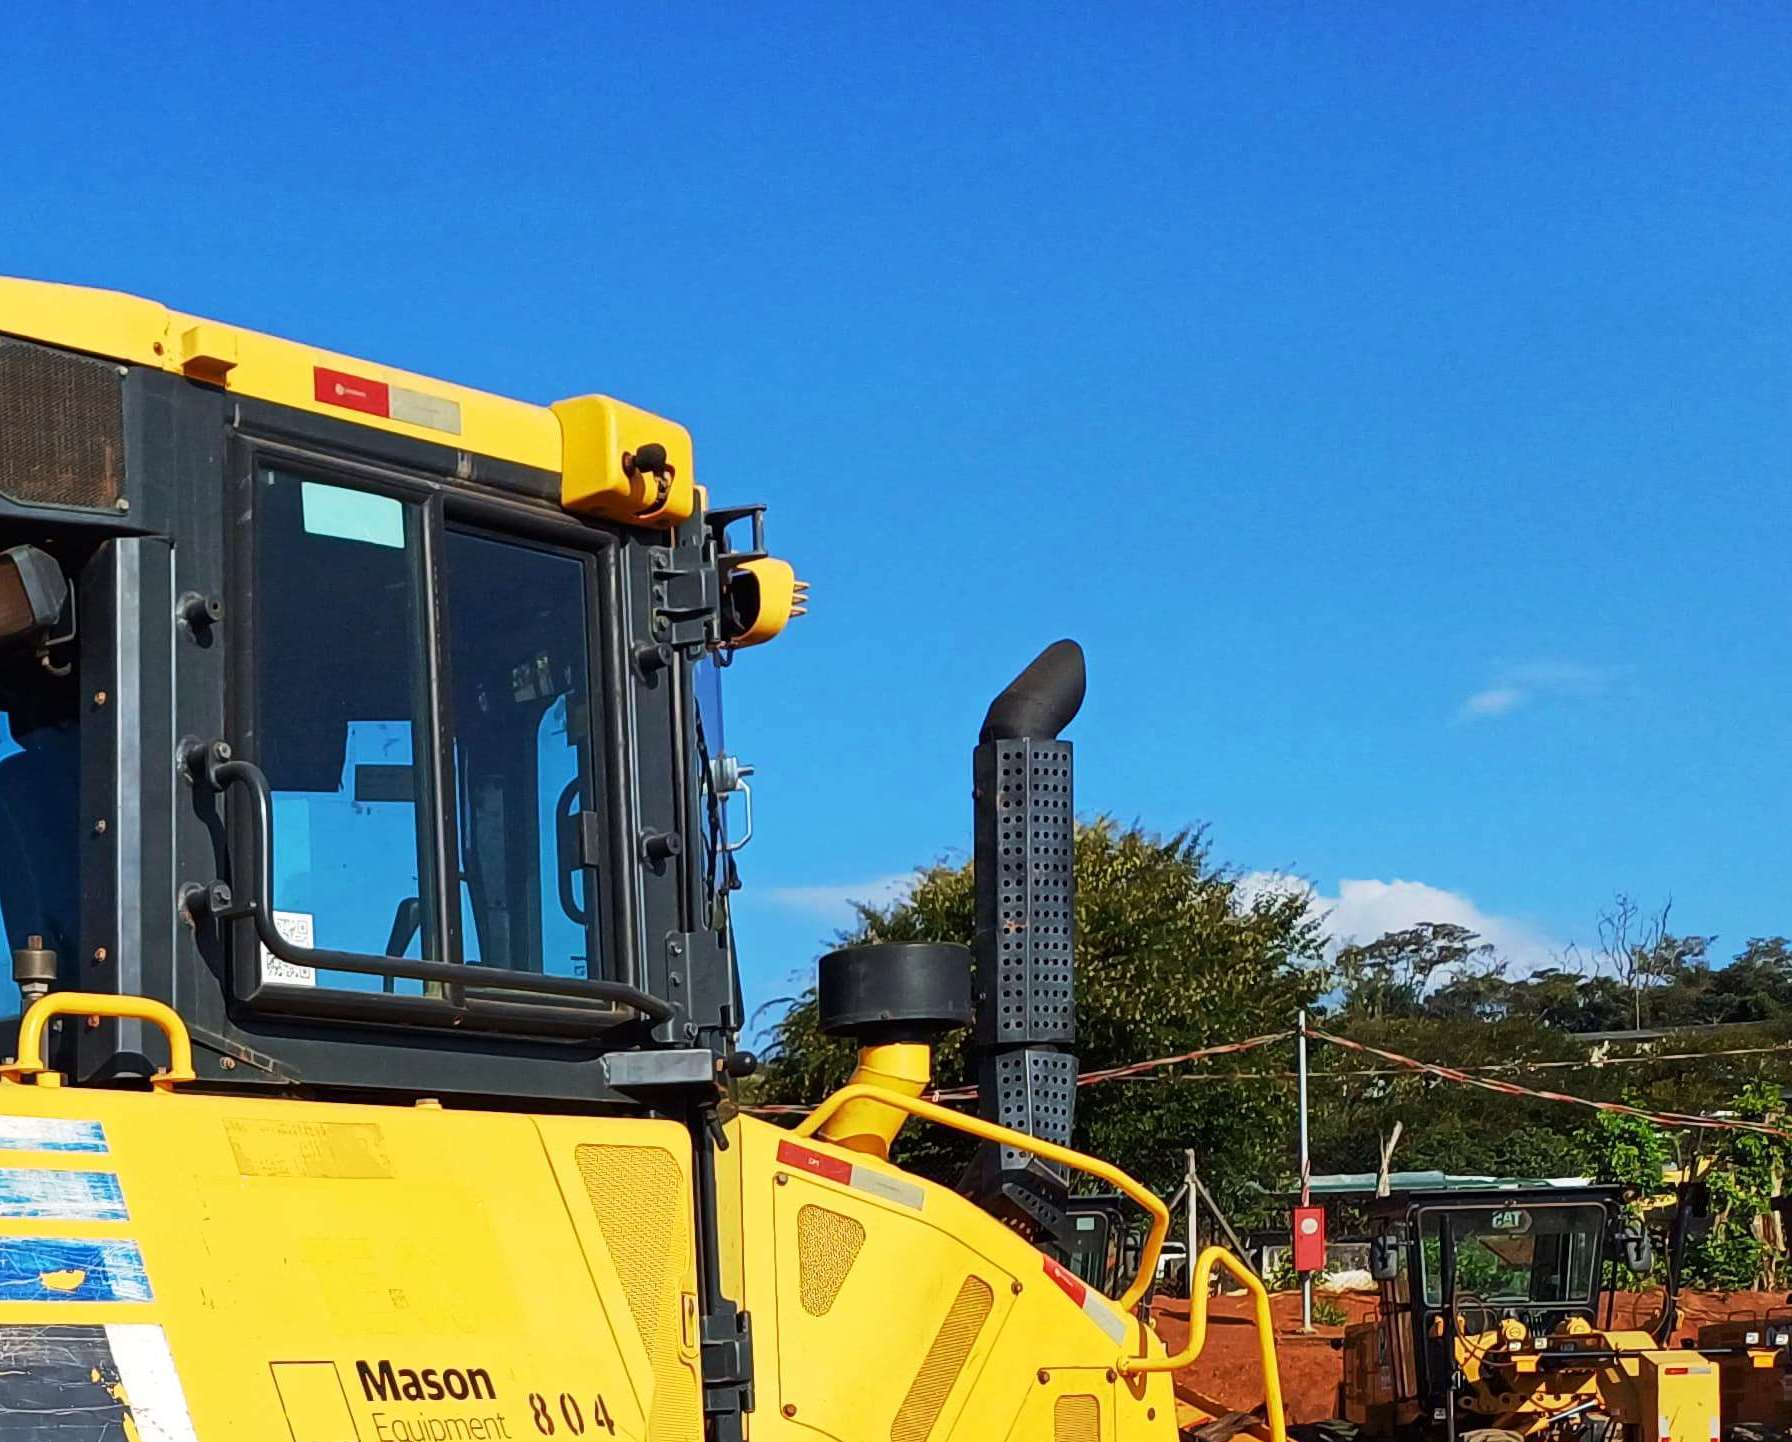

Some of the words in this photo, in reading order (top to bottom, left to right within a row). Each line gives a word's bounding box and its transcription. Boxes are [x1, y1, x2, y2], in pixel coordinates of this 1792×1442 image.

[1492, 1210, 1522, 1229] CAT
[355, 1360, 497, 1401] Mason
[528, 1392, 615, 1436] 804
